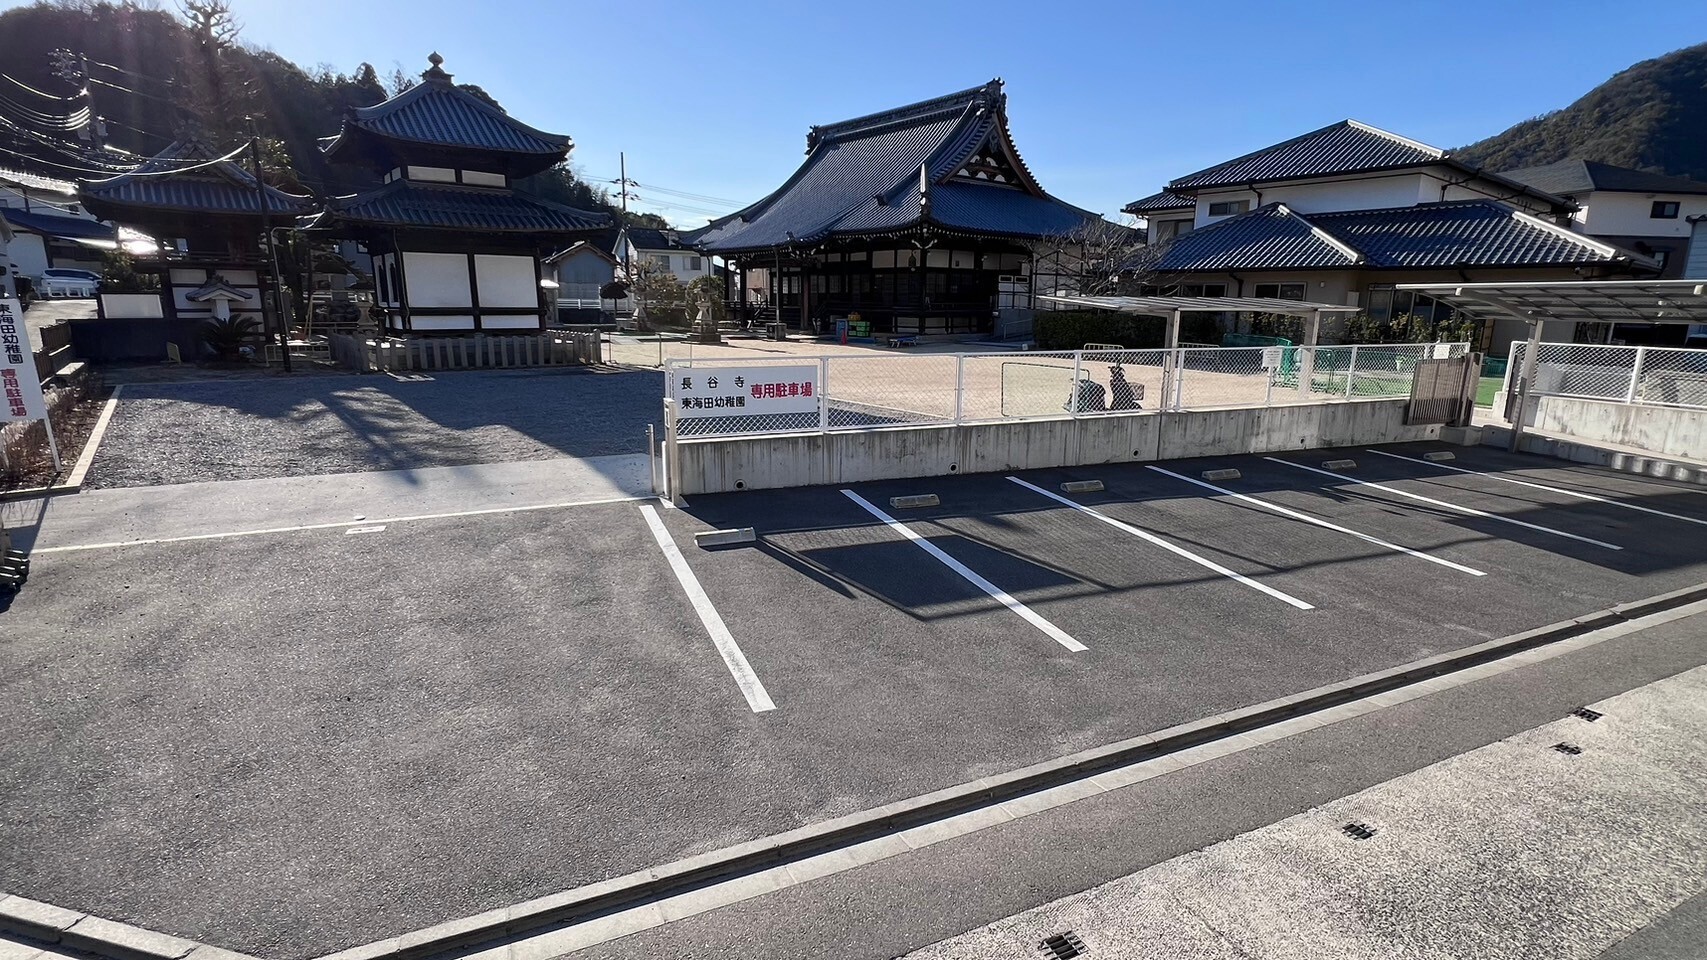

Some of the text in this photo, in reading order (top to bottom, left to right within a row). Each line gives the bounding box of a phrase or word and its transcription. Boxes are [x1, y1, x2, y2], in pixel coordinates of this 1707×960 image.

[0, 304, 24, 364] 東海田幼稚園
[0, 368, 27, 417] 専用駐車場
[681, 396, 745, 410] 東海田幼稚園
[750, 381, 812, 399] 専用駐車場
